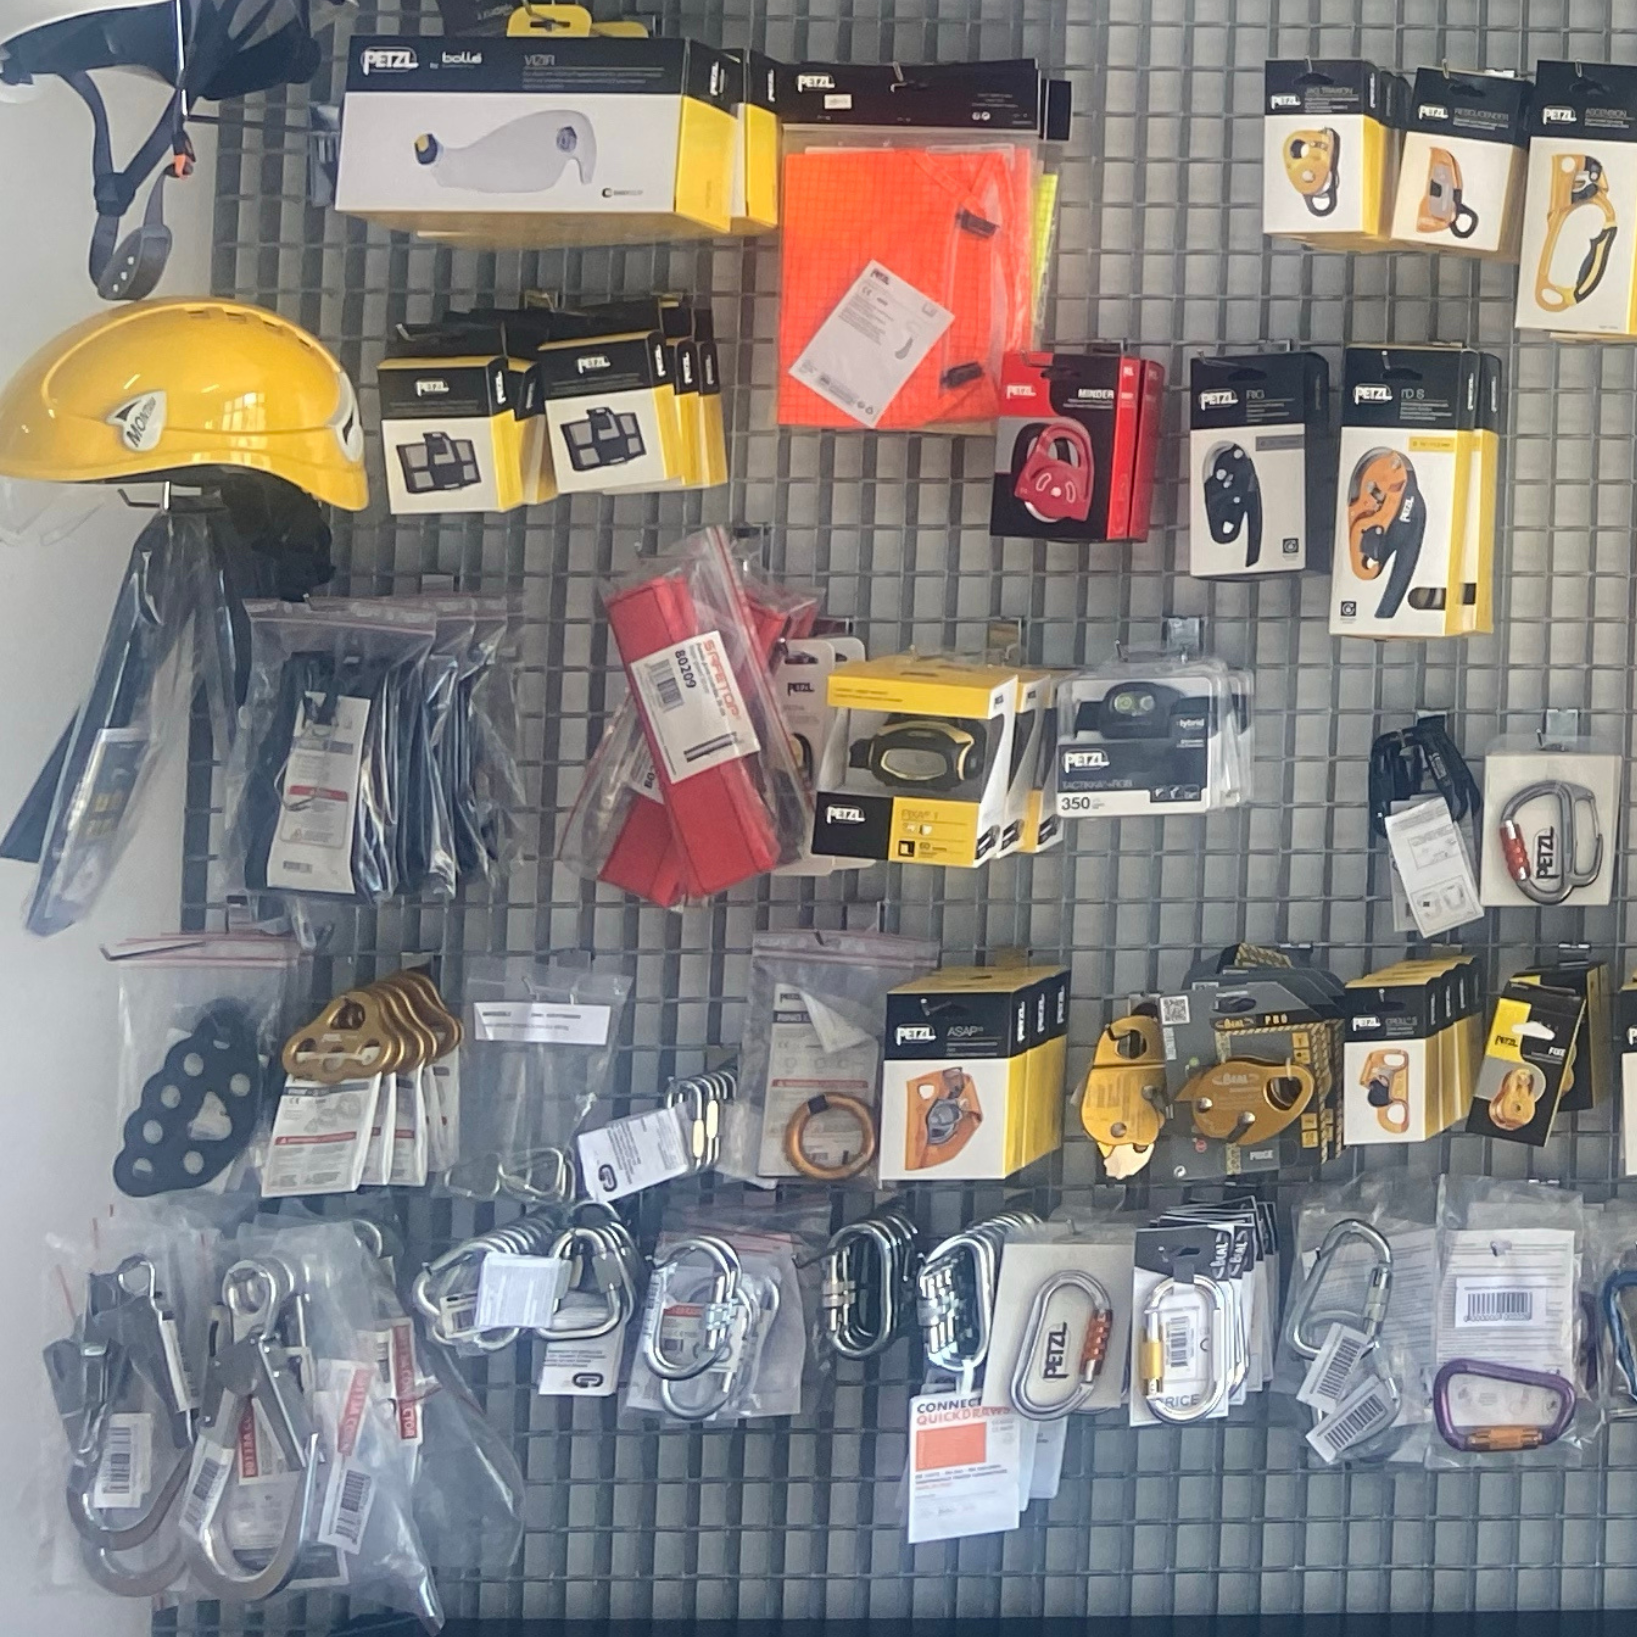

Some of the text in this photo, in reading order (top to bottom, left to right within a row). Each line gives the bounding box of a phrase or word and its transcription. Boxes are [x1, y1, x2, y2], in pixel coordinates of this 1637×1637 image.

[363, 50, 419, 76] PETZL
[797, 75, 835, 93] PETZL
[1542, 106, 1577, 125] PETZL
[1201, 391, 1238, 411] PETZL
[1355, 386, 1393, 405] PETZL
[674, 649, 697, 689] 80209
[1064, 752, 1110, 774] PETZL
[1061, 796, 1090, 810] 350
[826, 806, 866, 824] PETZL
[1535, 825, 1561, 880] PETZL
[896, 1027, 936, 1045] PETZL
[1042, 1321, 1070, 1380] PETZL
